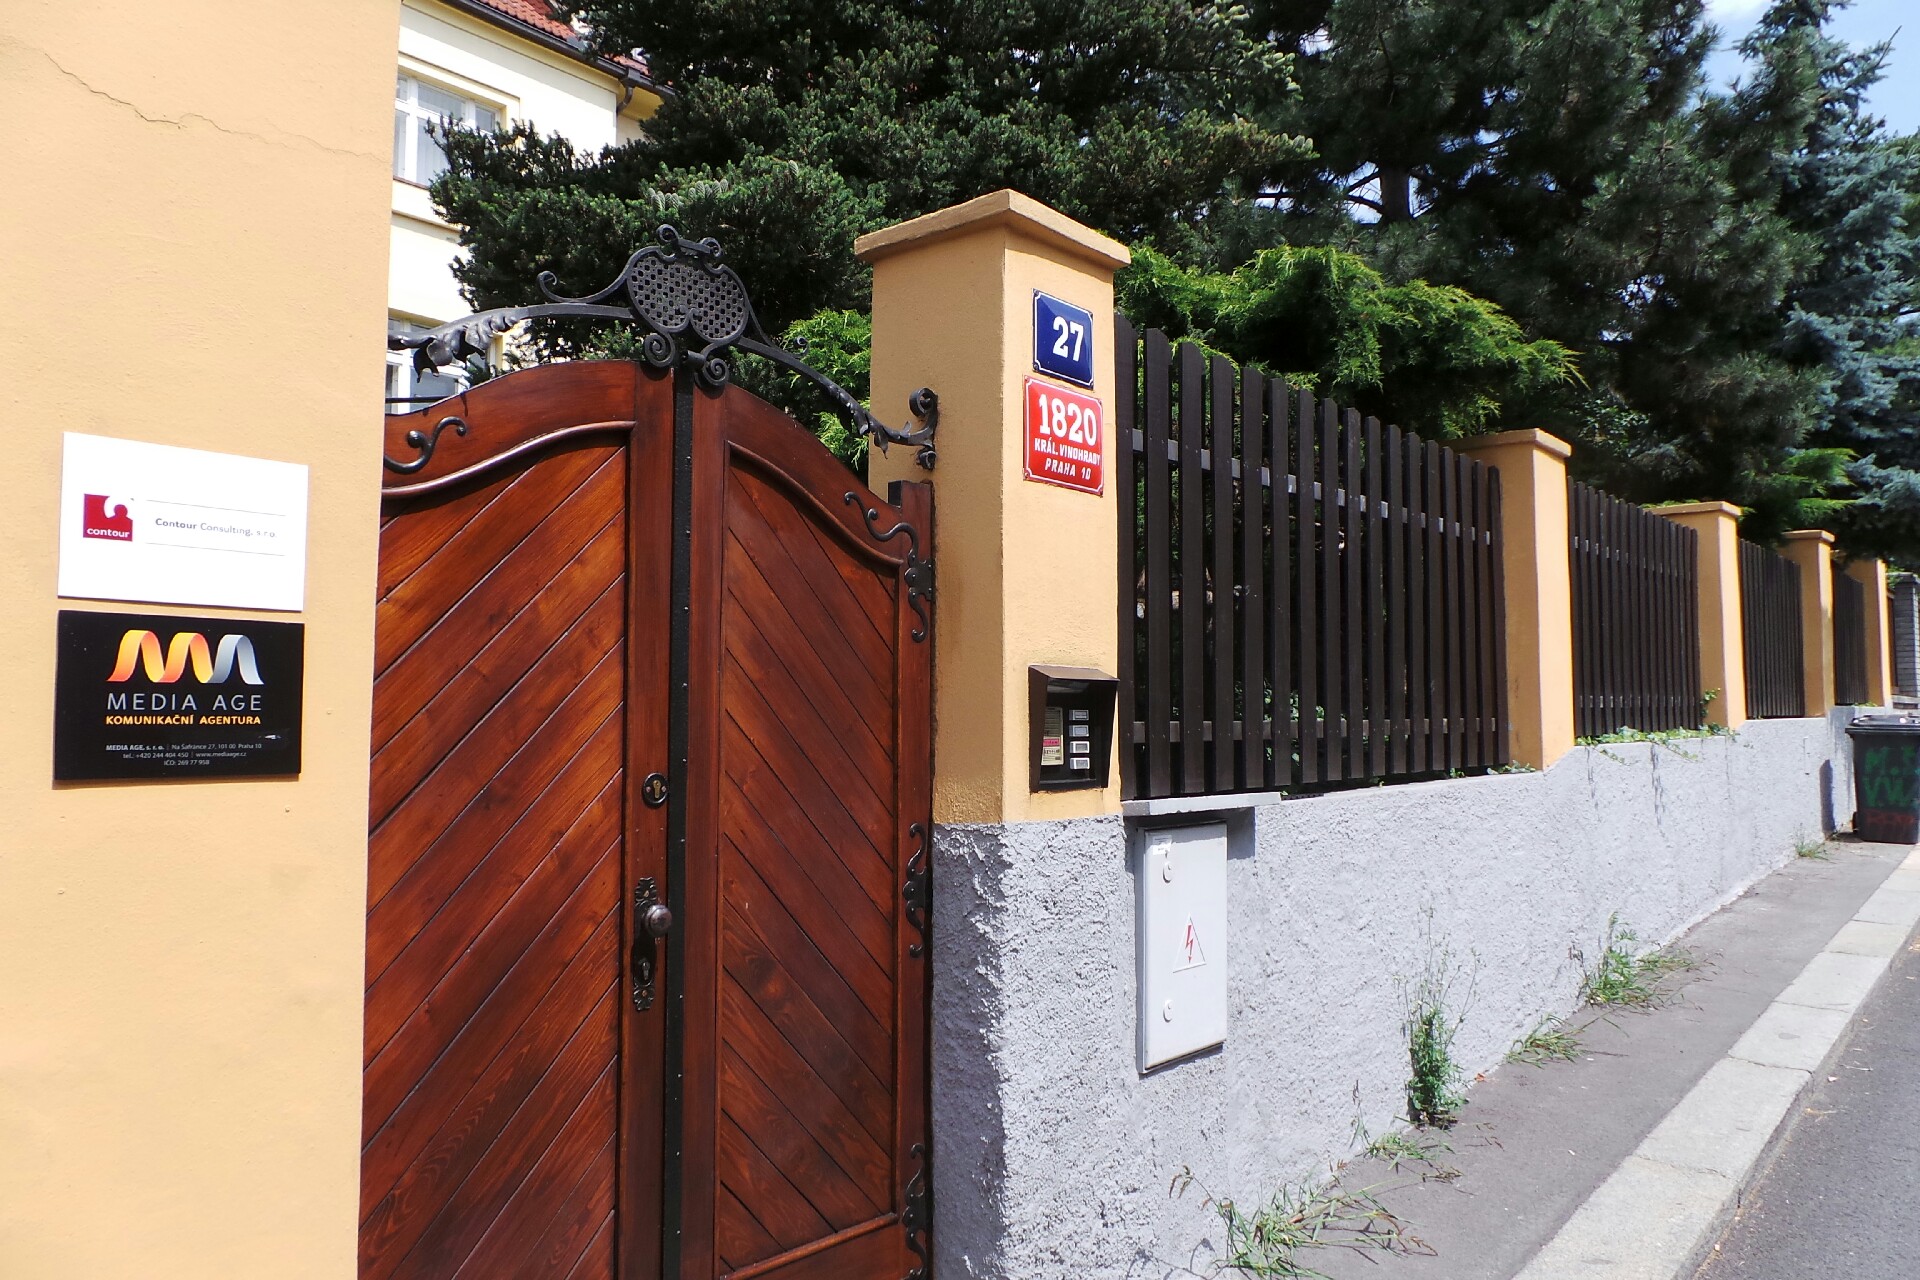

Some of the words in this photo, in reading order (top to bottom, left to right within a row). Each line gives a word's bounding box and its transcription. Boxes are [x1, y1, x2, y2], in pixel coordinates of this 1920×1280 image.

[1052, 316, 1084, 362] 27
[1039, 393, 1097, 446] 1820
[1034, 437, 1059, 456] KRÁL.
[1059, 443, 1101, 466] VINOHRADY
[1045, 458, 1076, 477] PRAHA
[1081, 467, 1092, 481] 10
[86, 528, 130, 538] contour
[155, 518, 198, 530] Contour
[107, 692, 198, 711] MEDIA
[212, 694, 262, 711] AGE
[105, 714, 194, 726] KOMUNIKAČNÍ
[199, 716, 261, 725] AGENTURA
